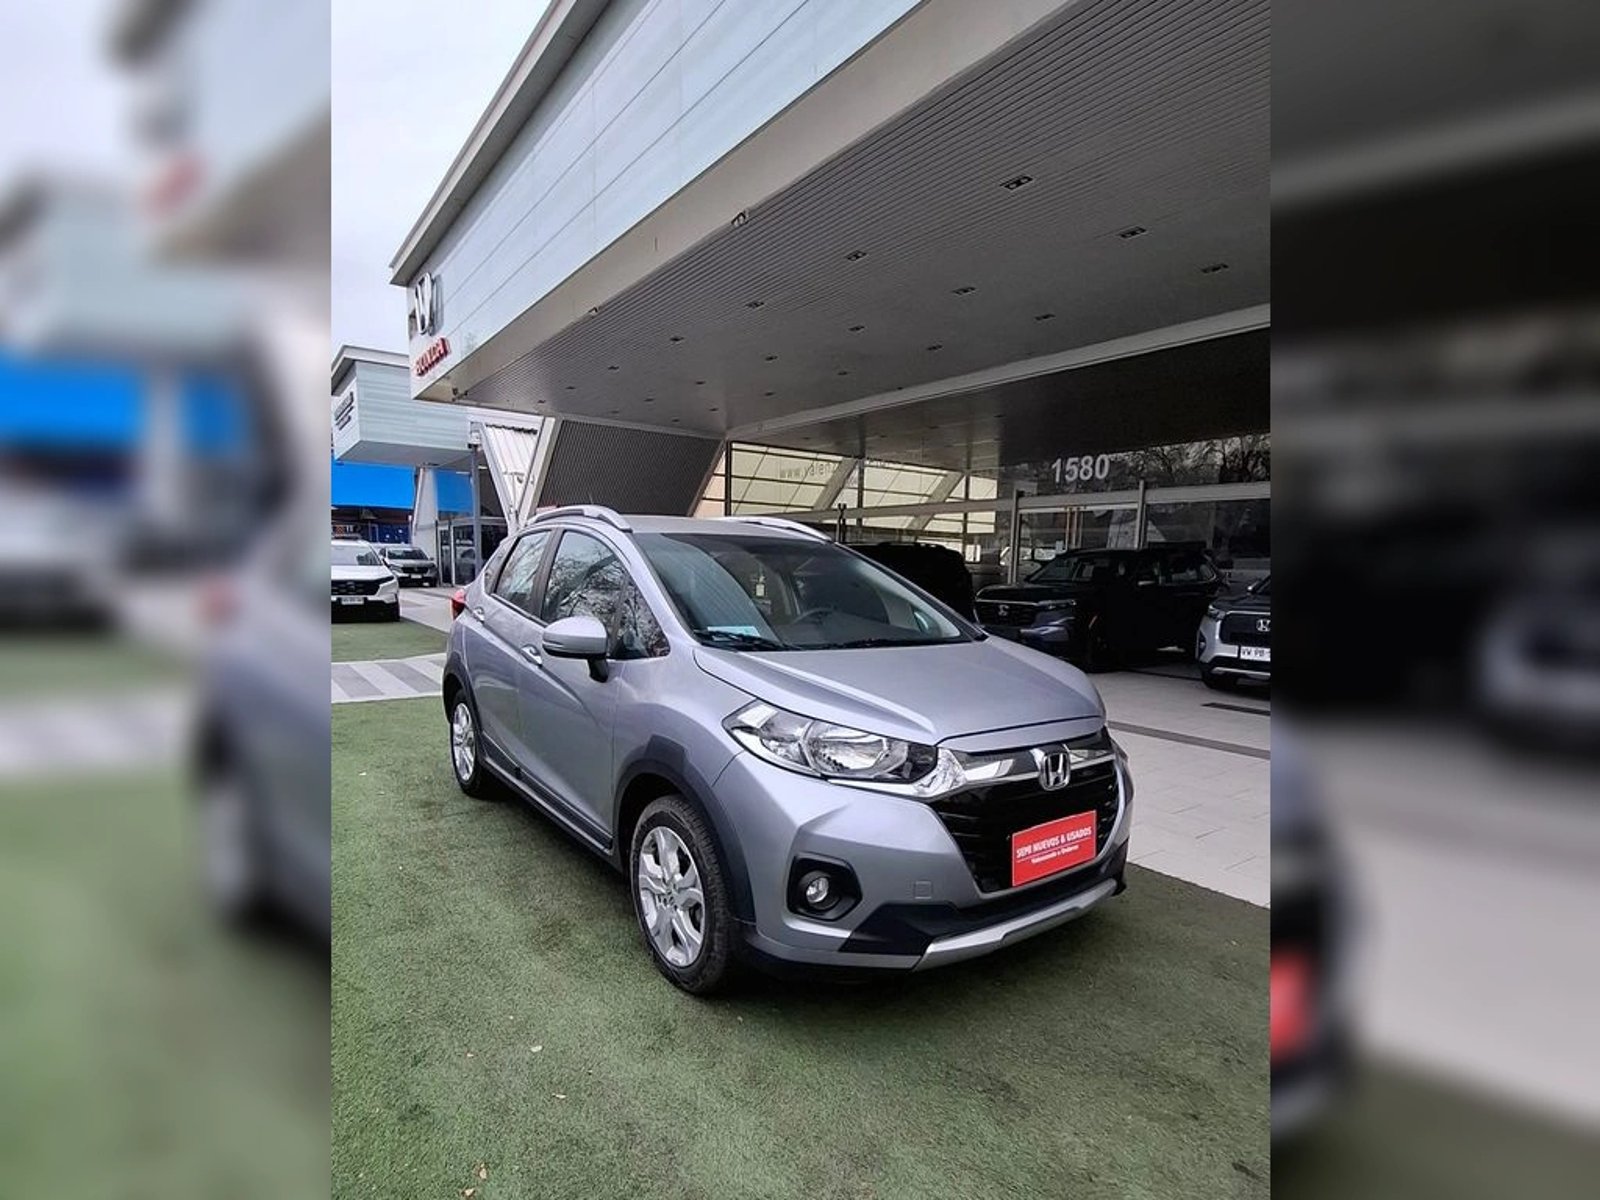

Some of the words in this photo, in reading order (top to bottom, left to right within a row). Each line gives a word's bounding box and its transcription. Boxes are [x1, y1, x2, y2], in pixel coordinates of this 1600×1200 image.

[1052, 454, 1110, 483] 1580
[1033, 836, 1060, 851] NUEVOS
[1067, 827, 1092, 841] USADOS
